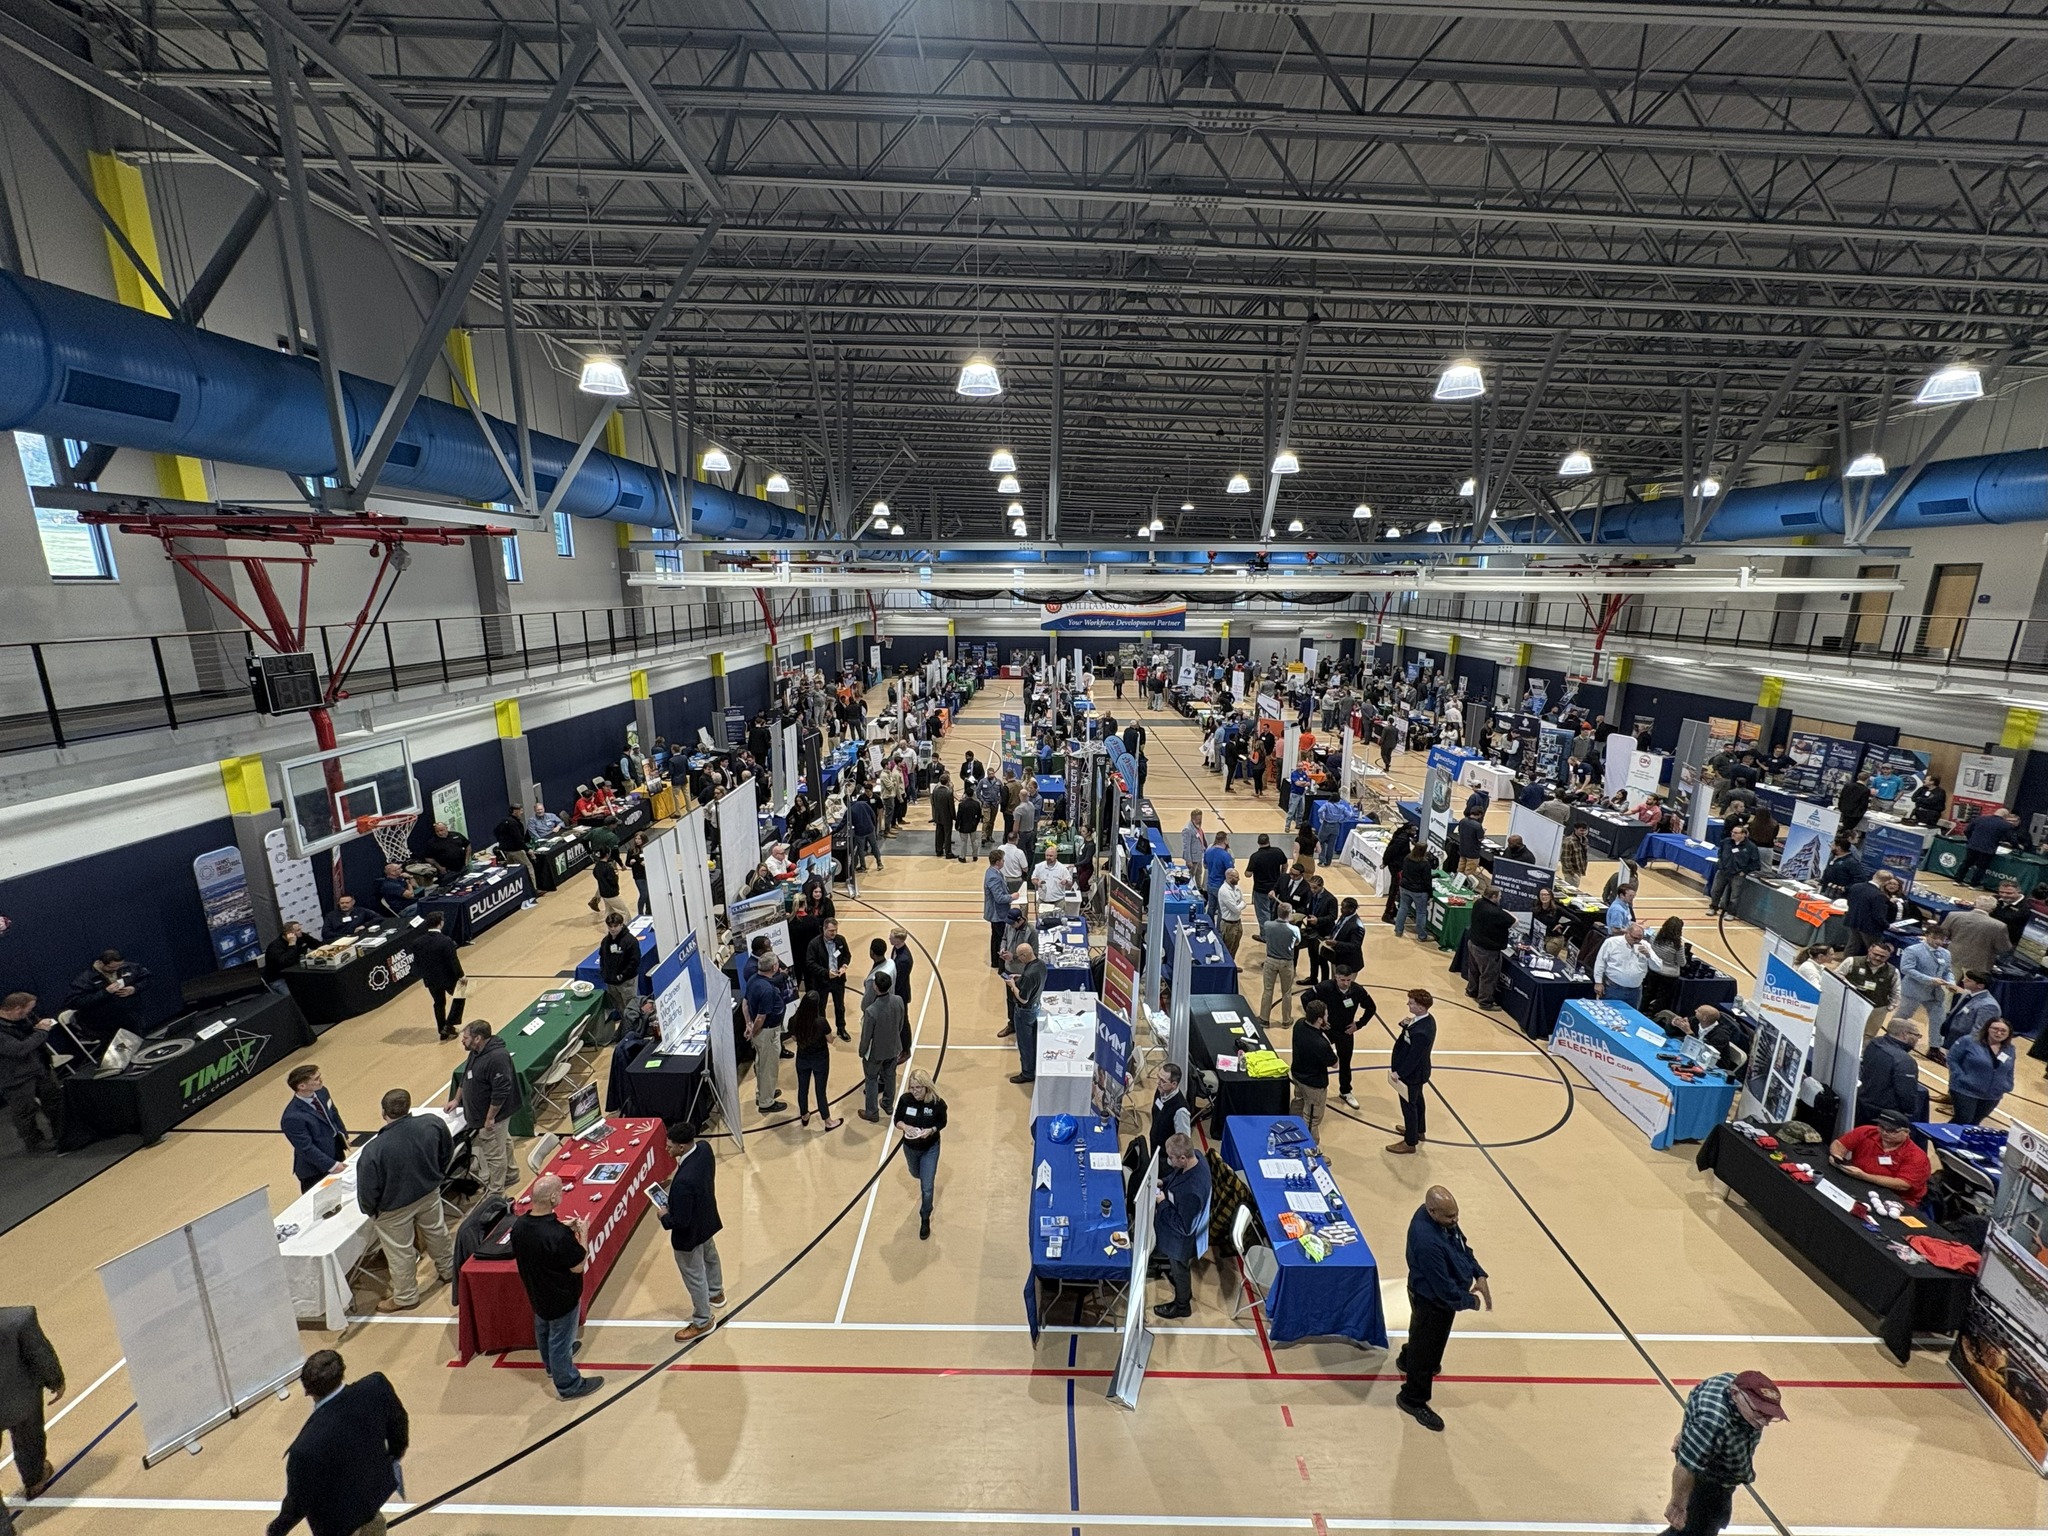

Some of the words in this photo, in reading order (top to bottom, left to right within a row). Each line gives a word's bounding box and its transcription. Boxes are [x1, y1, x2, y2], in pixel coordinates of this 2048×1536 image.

[1066, 602, 1127, 610] WILLIAMSON
[1068, 618, 1083, 626] Your
[1084, 618, 1115, 627] Workforce
[1116, 618, 1156, 627] Development
[1157, 619, 1181, 627] Partner
[1495, 874, 1537, 888] MANUFACTURING
[1985, 869, 2017, 881] RNOVA
[470, 877, 523, 919] PULLMAN
[679, 939, 697, 962] CLARK
[663, 982, 681, 1005] Career
[661, 1000, 677, 1020] Worth
[662, 1006, 682, 1031] Building
[180, 1038, 256, 1099] TIMET
[583, 1145, 655, 1275] Honeywell
